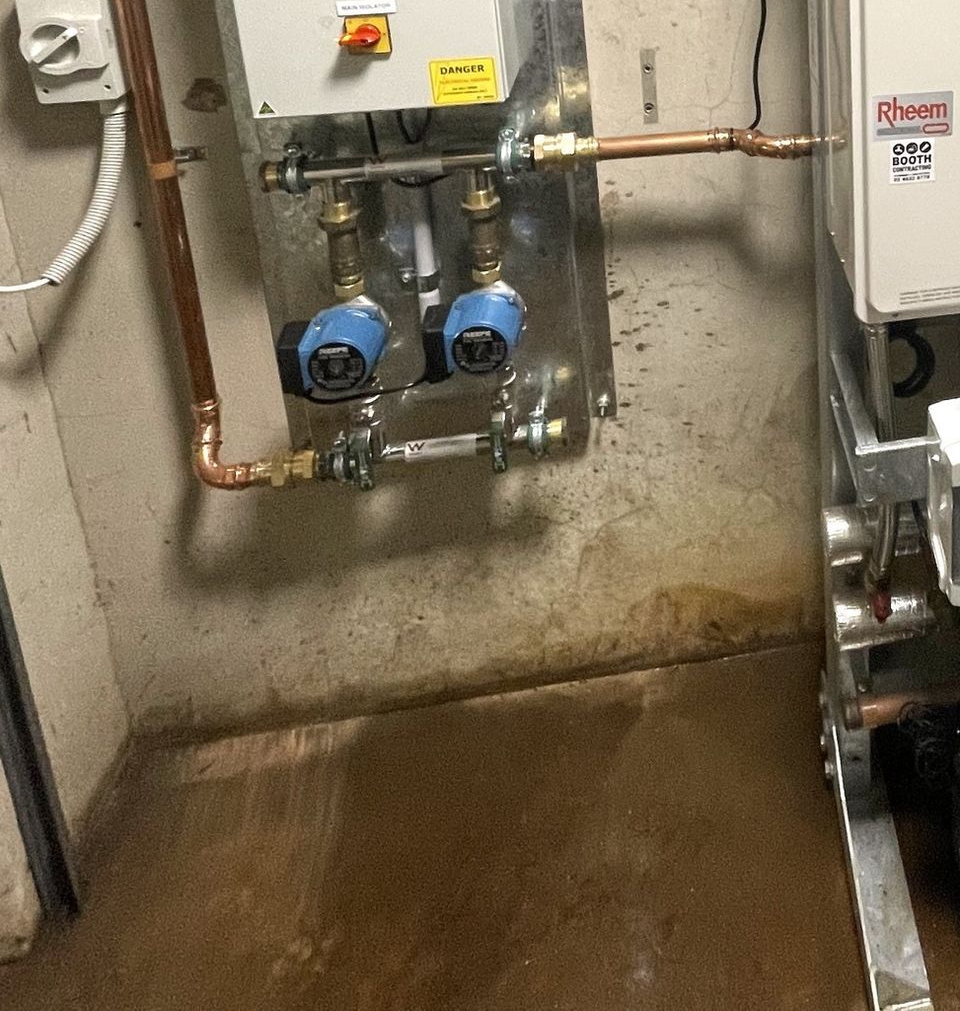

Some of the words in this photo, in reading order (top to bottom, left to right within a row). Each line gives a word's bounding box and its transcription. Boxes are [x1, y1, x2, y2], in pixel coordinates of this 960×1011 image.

[440, 64, 485, 75] DANGER
[877, 97, 947, 129] Rheem
[892, 154, 932, 166] BOOTH
[892, 164, 932, 173] CONTRACTING
